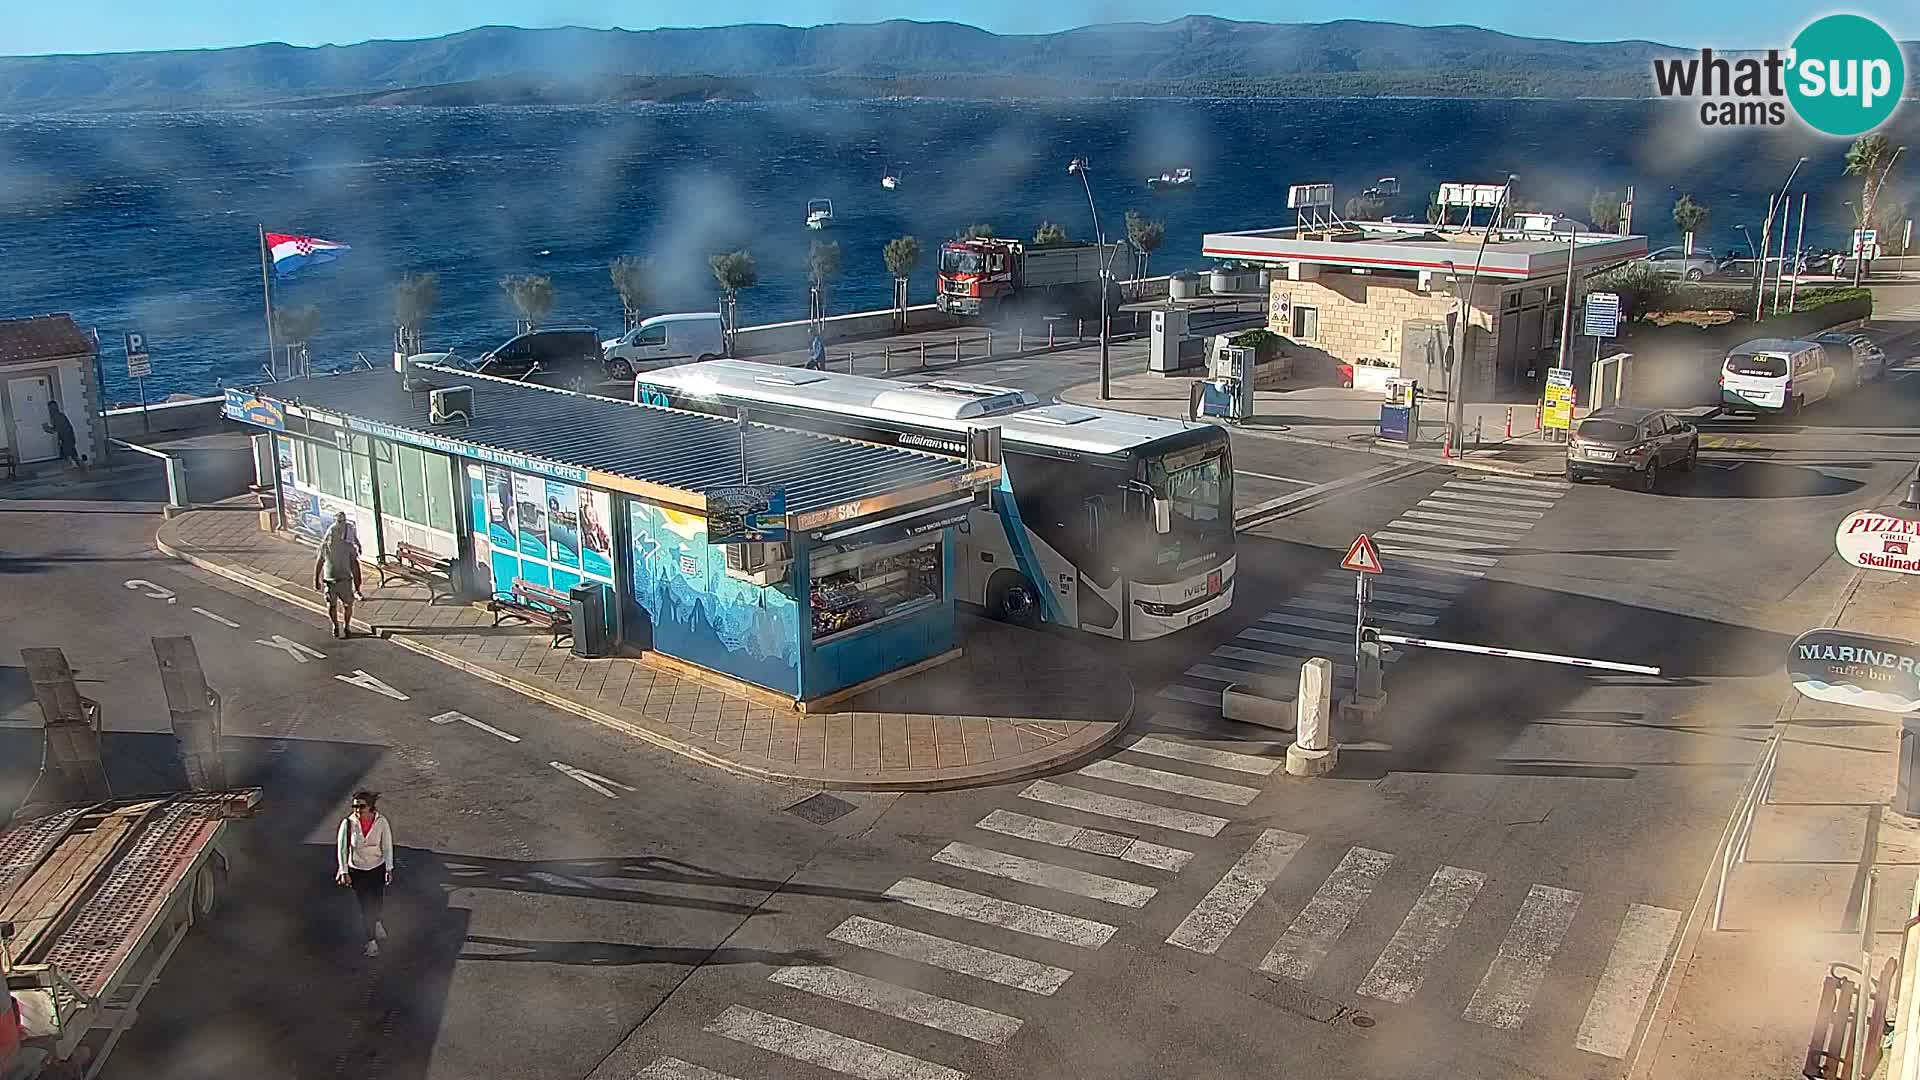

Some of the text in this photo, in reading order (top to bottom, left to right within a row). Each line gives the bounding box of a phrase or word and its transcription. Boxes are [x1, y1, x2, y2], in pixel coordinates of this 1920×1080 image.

[437, 440, 467, 455] POSTAJA
[477, 448, 492, 461] BUS
[493, 451, 526, 468] STATION
[528, 457, 553, 474] TICKET
[555, 463, 582, 480] OFFICE
[1848, 518, 1920, 535] PIZZE
[1880, 532, 1915, 544] GRILL
[1184, 582, 1208, 598] IVEC
[1868, 668, 1895, 681] bar
